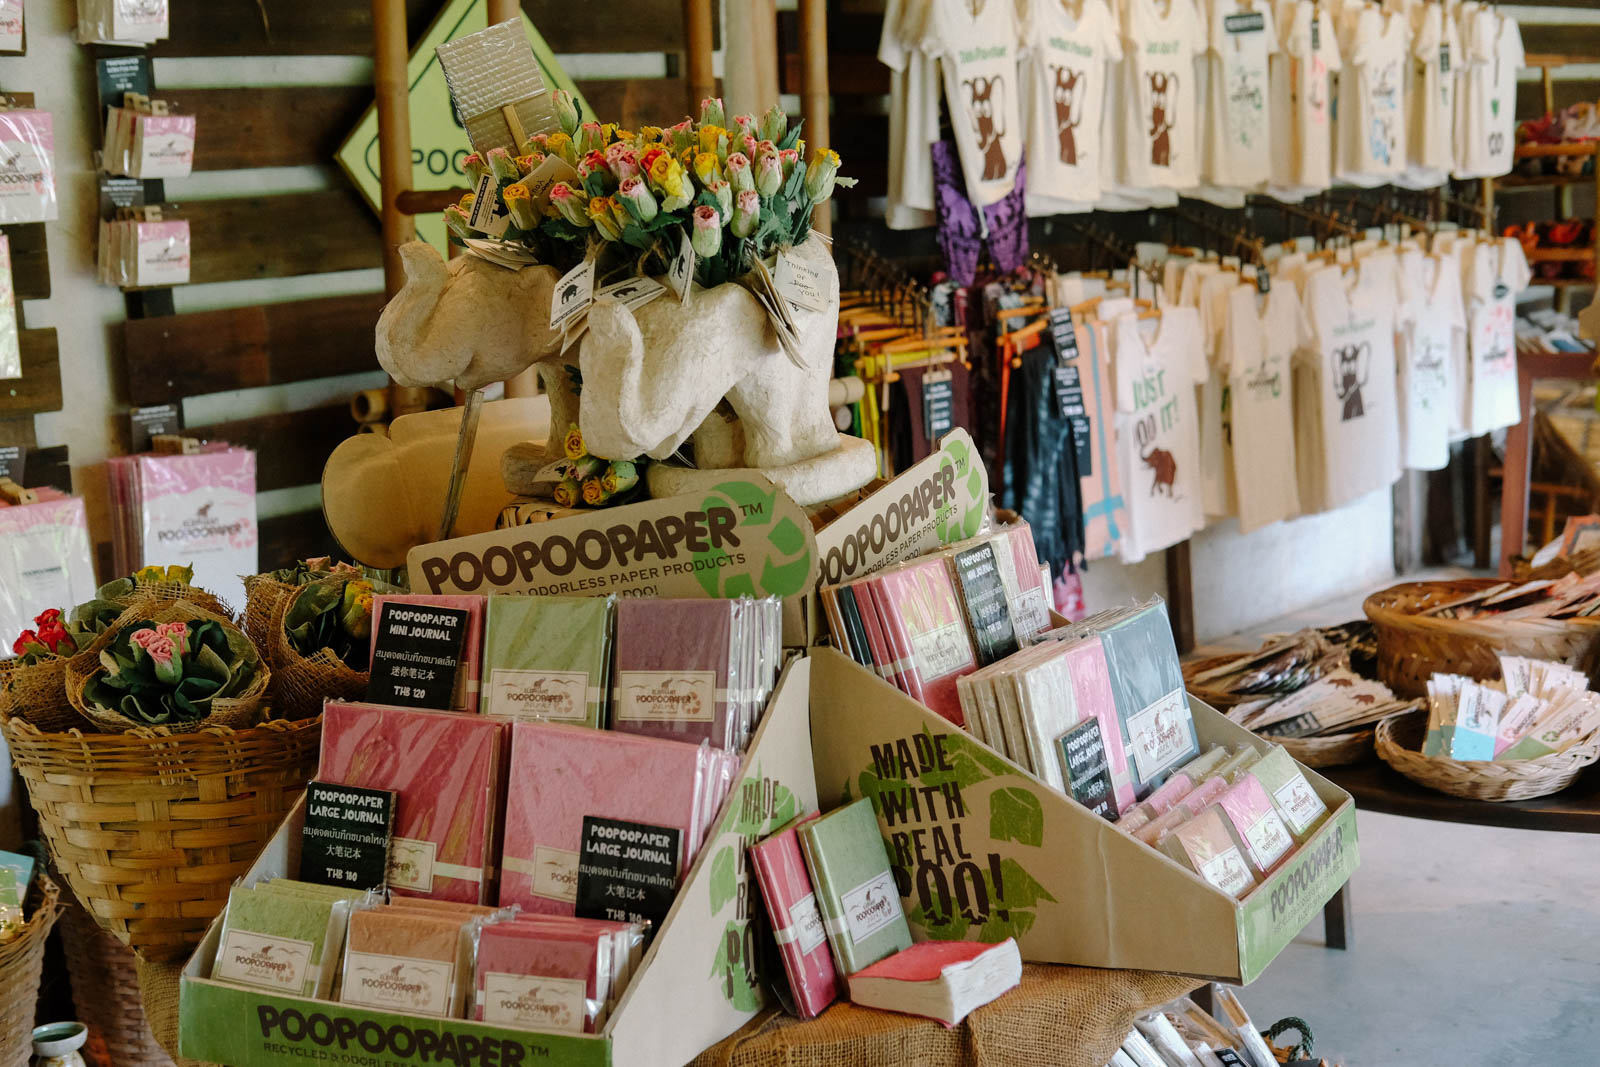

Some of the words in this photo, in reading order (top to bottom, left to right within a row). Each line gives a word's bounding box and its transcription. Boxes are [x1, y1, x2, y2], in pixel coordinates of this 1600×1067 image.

[899, 530, 922, 553] PAPER
[922, 504, 958, 535] PRODUCTS
[421, 506, 741, 595] POOPOOPAPER
[610, 567, 659, 585] PAPER
[663, 553, 746, 577] PRODUCTS
[388, 609, 458, 627] POOPOOPAPER
[389, 624, 408, 635] MINI
[409, 627, 451, 641] JOURNAL
[390, 665, 436, 681] 迷你笔记本
[394, 685, 411, 697] THB
[413, 689, 426, 699] 120
[507, 693, 564, 703] POOPOOPAPER
[636, 695, 692, 704] POOPOOPAPER
[870, 733, 954, 780] MADE
[313, 789, 384, 809] POOPOOPAPER
[741, 777, 780, 825] MADE
[879, 781, 965, 827] WITH
[309, 804, 341, 818] LARGE
[341, 808, 385, 825] JOURNAL
[590, 824, 671, 848] POOPOOPAPER
[325, 844, 361, 860] 大笔记本
[586, 840, 621, 857] LARGE
[622, 846, 672, 865] JOURNAL
[892, 823, 972, 868] REAL
[326, 867, 343, 880] THB
[606, 883, 646, 901] 大笔记本
[606, 908, 626, 921] THB
[235, 955, 287, 972] POOPOOPAPER
[361, 978, 423, 993] POOPOOPAPER
[500, 1000, 561, 1014] POOPOOPAPER
[257, 1004, 527, 1067] POOPOOPAPER
[263, 1042, 328, 1061] RECYCLED
